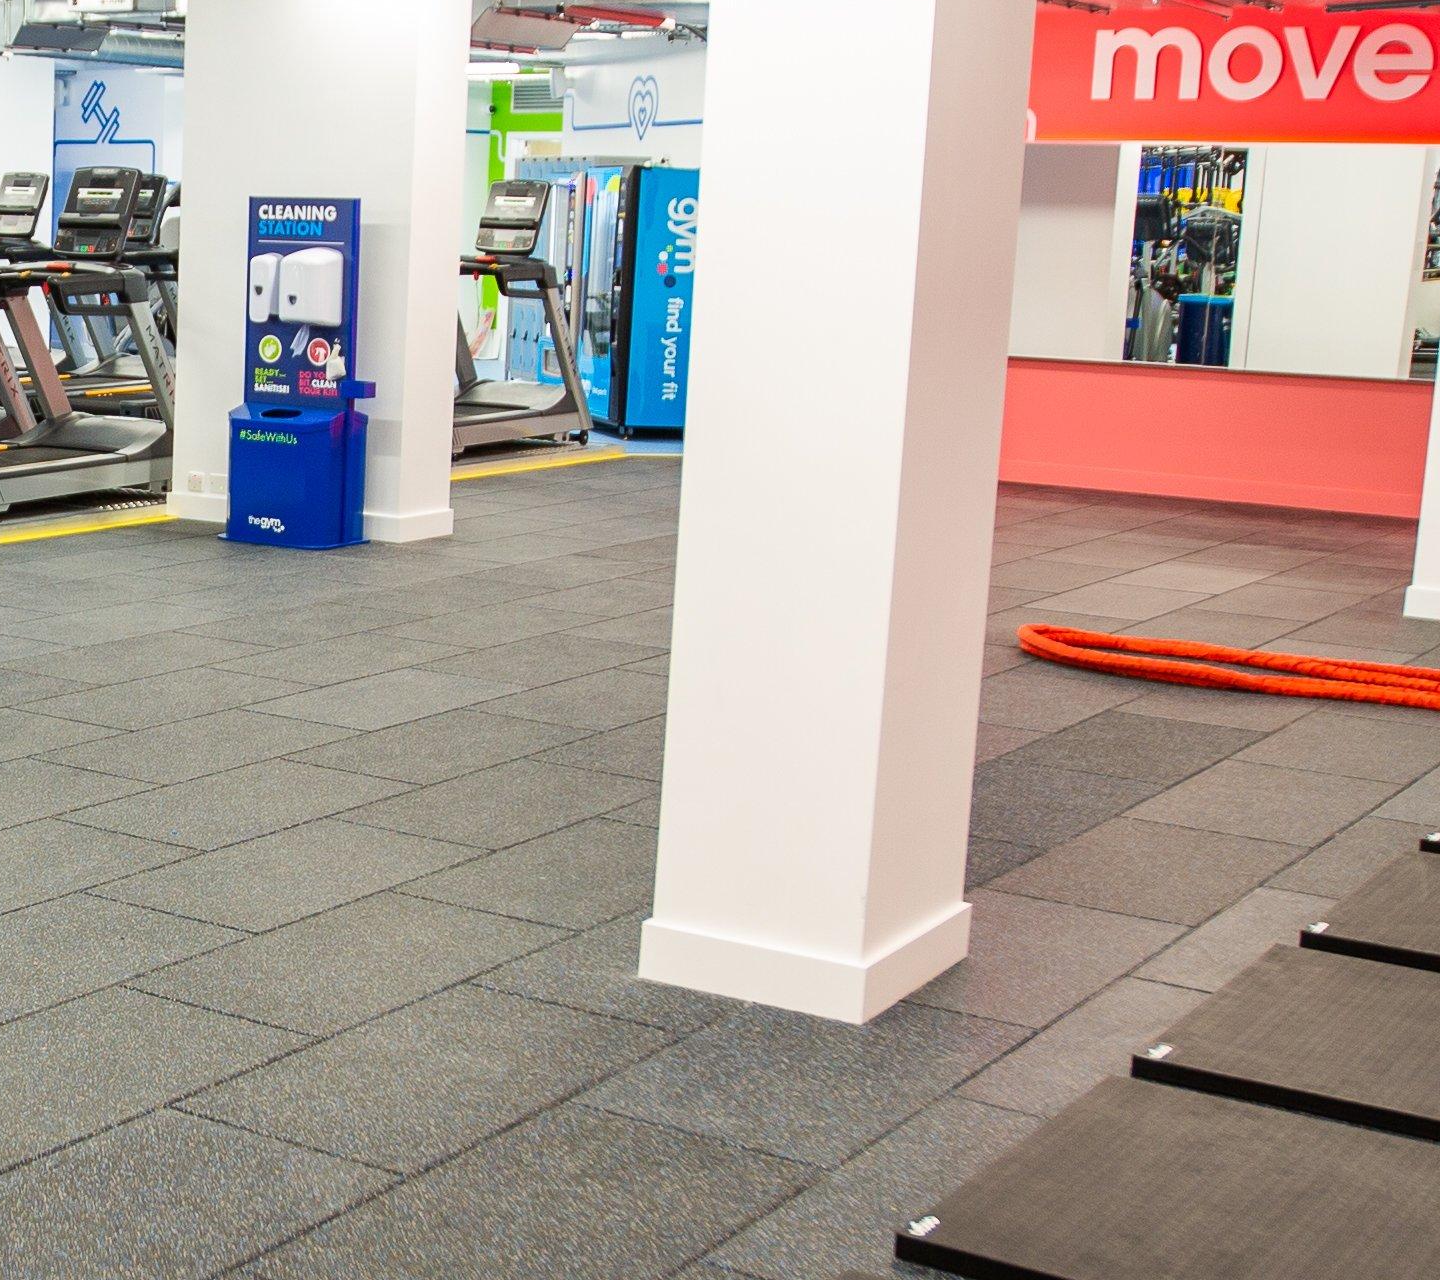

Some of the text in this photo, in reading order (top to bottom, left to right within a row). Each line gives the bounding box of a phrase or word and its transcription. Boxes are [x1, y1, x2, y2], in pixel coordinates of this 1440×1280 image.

[1090, 23, 1435, 102] move
[258, 204, 337, 222] CLEANING
[258, 221, 323, 236] STATION
[667, 197, 698, 274] gym
[145, 324, 176, 404] MATRI
[661, 297, 684, 401] find your fit
